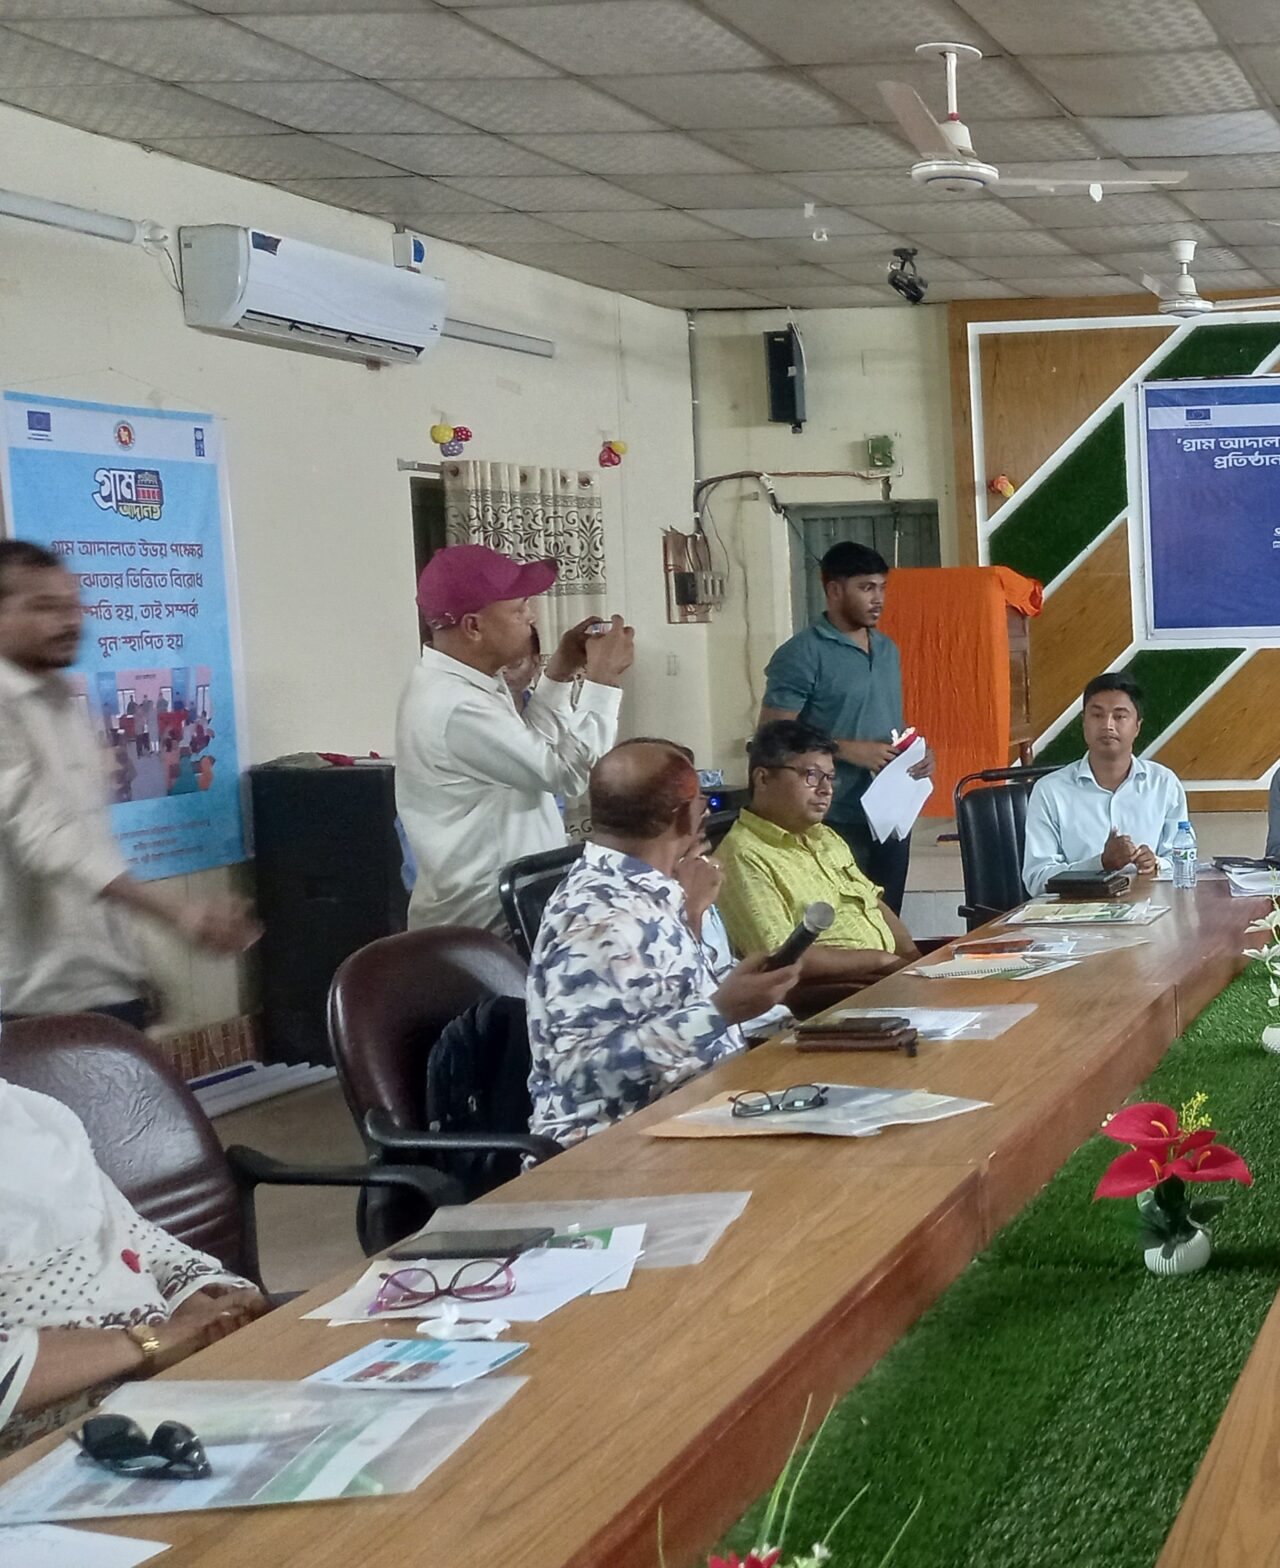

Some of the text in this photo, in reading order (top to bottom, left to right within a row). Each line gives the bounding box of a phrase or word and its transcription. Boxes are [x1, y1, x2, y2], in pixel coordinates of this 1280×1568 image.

[92, 468, 137, 512] গ্রাম
[119, 503, 161, 521] আদালত
[77, 540, 137, 557] আদালতে
[138, 539, 167, 559] উভয়
[126, 567, 168, 589] ভিত্তিতে
[169, 568, 203, 589] বিরোধ
[140, 600, 163, 619] তাই
[165, 598, 199, 618] সম্পর্ক
[165, 634, 184, 650] হয়
